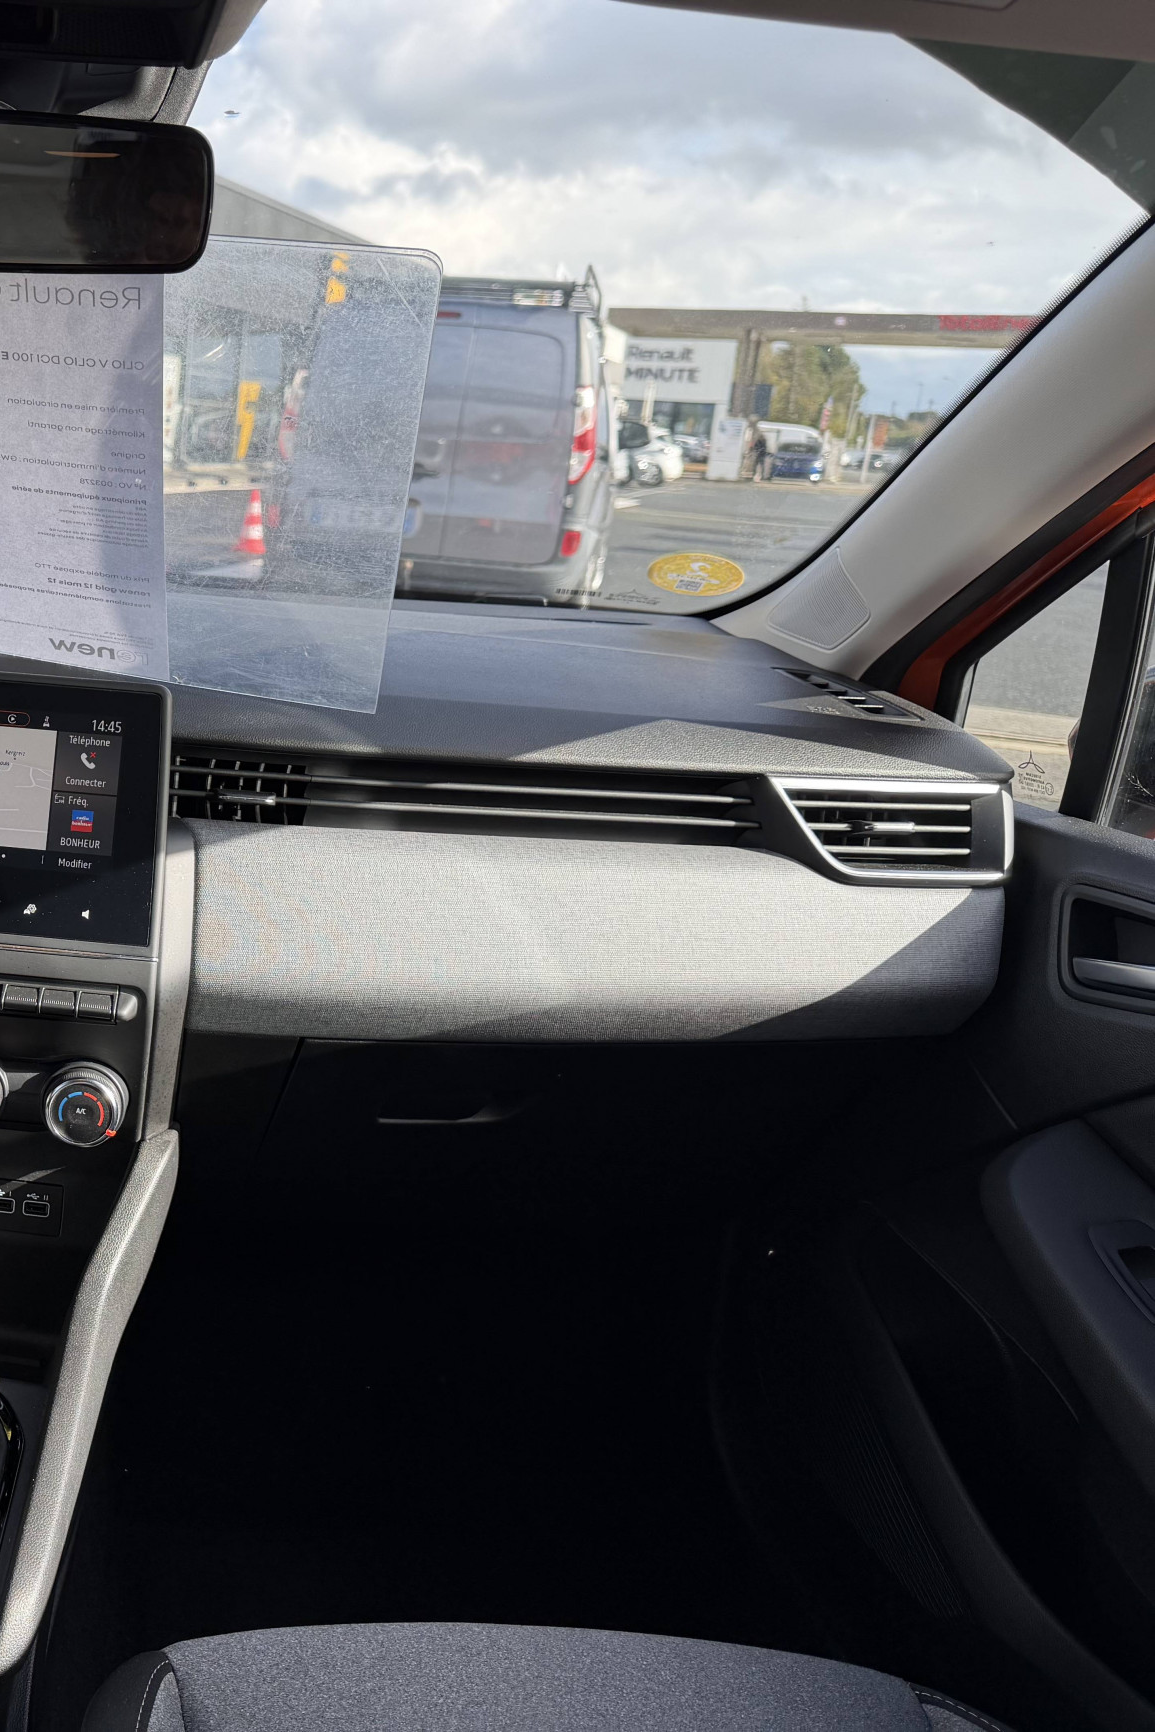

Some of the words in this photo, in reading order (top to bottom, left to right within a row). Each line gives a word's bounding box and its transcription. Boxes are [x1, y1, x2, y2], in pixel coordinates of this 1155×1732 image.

[628, 345, 694, 362] Renault
[626, 367, 700, 384] MINUTE
[91, 719, 122, 734] 14:45
[69, 734, 111, 749] Téléphone
[65, 776, 106, 789] Connecter
[68, 795, 89, 808] Fréq.
[60, 837, 101, 850] BONHEUR
[57, 858, 93, 871] Modifier
[76, 1107, 87, 1116] A/C
